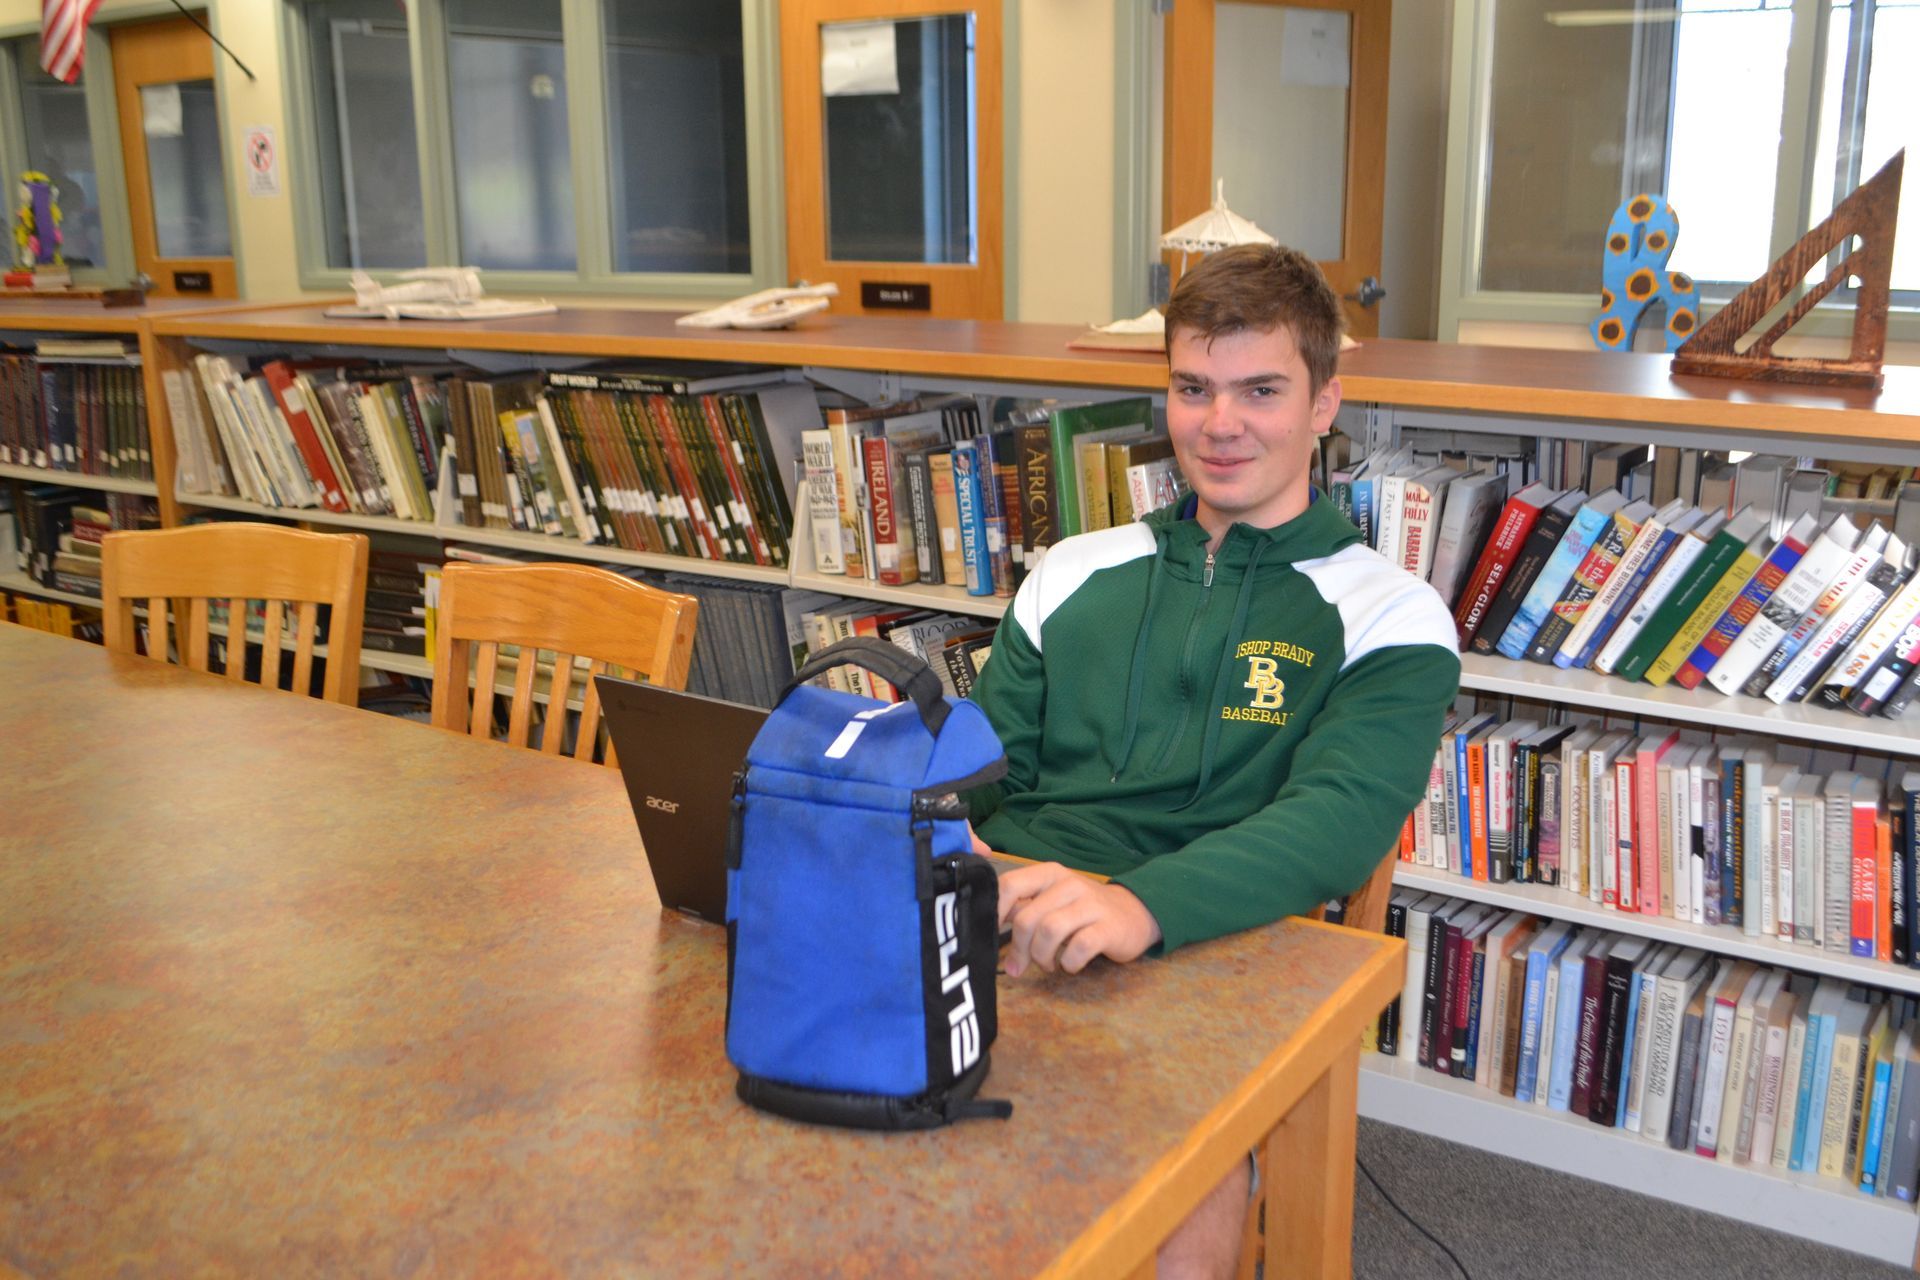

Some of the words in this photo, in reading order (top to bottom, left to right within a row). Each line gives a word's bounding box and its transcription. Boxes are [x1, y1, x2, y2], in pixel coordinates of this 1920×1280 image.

[804, 441, 832, 454] WORLD
[870, 459, 891, 536] IRELAND
[957, 476, 974, 526] SPECIAL
[1025, 446, 1051, 547] AFRICAN
[1132, 478, 1145, 513] Atkin
[1404, 506, 1430, 521] FOLLY
[961, 526, 977, 564] TRUST
[1613, 525, 1631, 544] To
[1639, 527, 1660, 552] HOME
[1596, 541, 1622, 569] Rule
[1625, 549, 1644, 572] FIRES
[1486, 563, 1502, 585] SEA
[1584, 565, 1605, 587] the
[1602, 570, 1629, 604] BURNING
[1464, 593, 1487, 628] GLORY
[1563, 584, 1592, 619] Waves
[1235, 641, 1271, 658] ISHOP
[1271, 641, 1315, 667] BRADY
[955, 676, 968, 699] WES
[1221, 707, 1294, 726] BASEBAL
[646, 795, 680, 814] acer
[1862, 858, 1873, 901] GAME
[1583, 996, 1599, 1012] The
[1711, 1017, 1729, 1054] 1912
